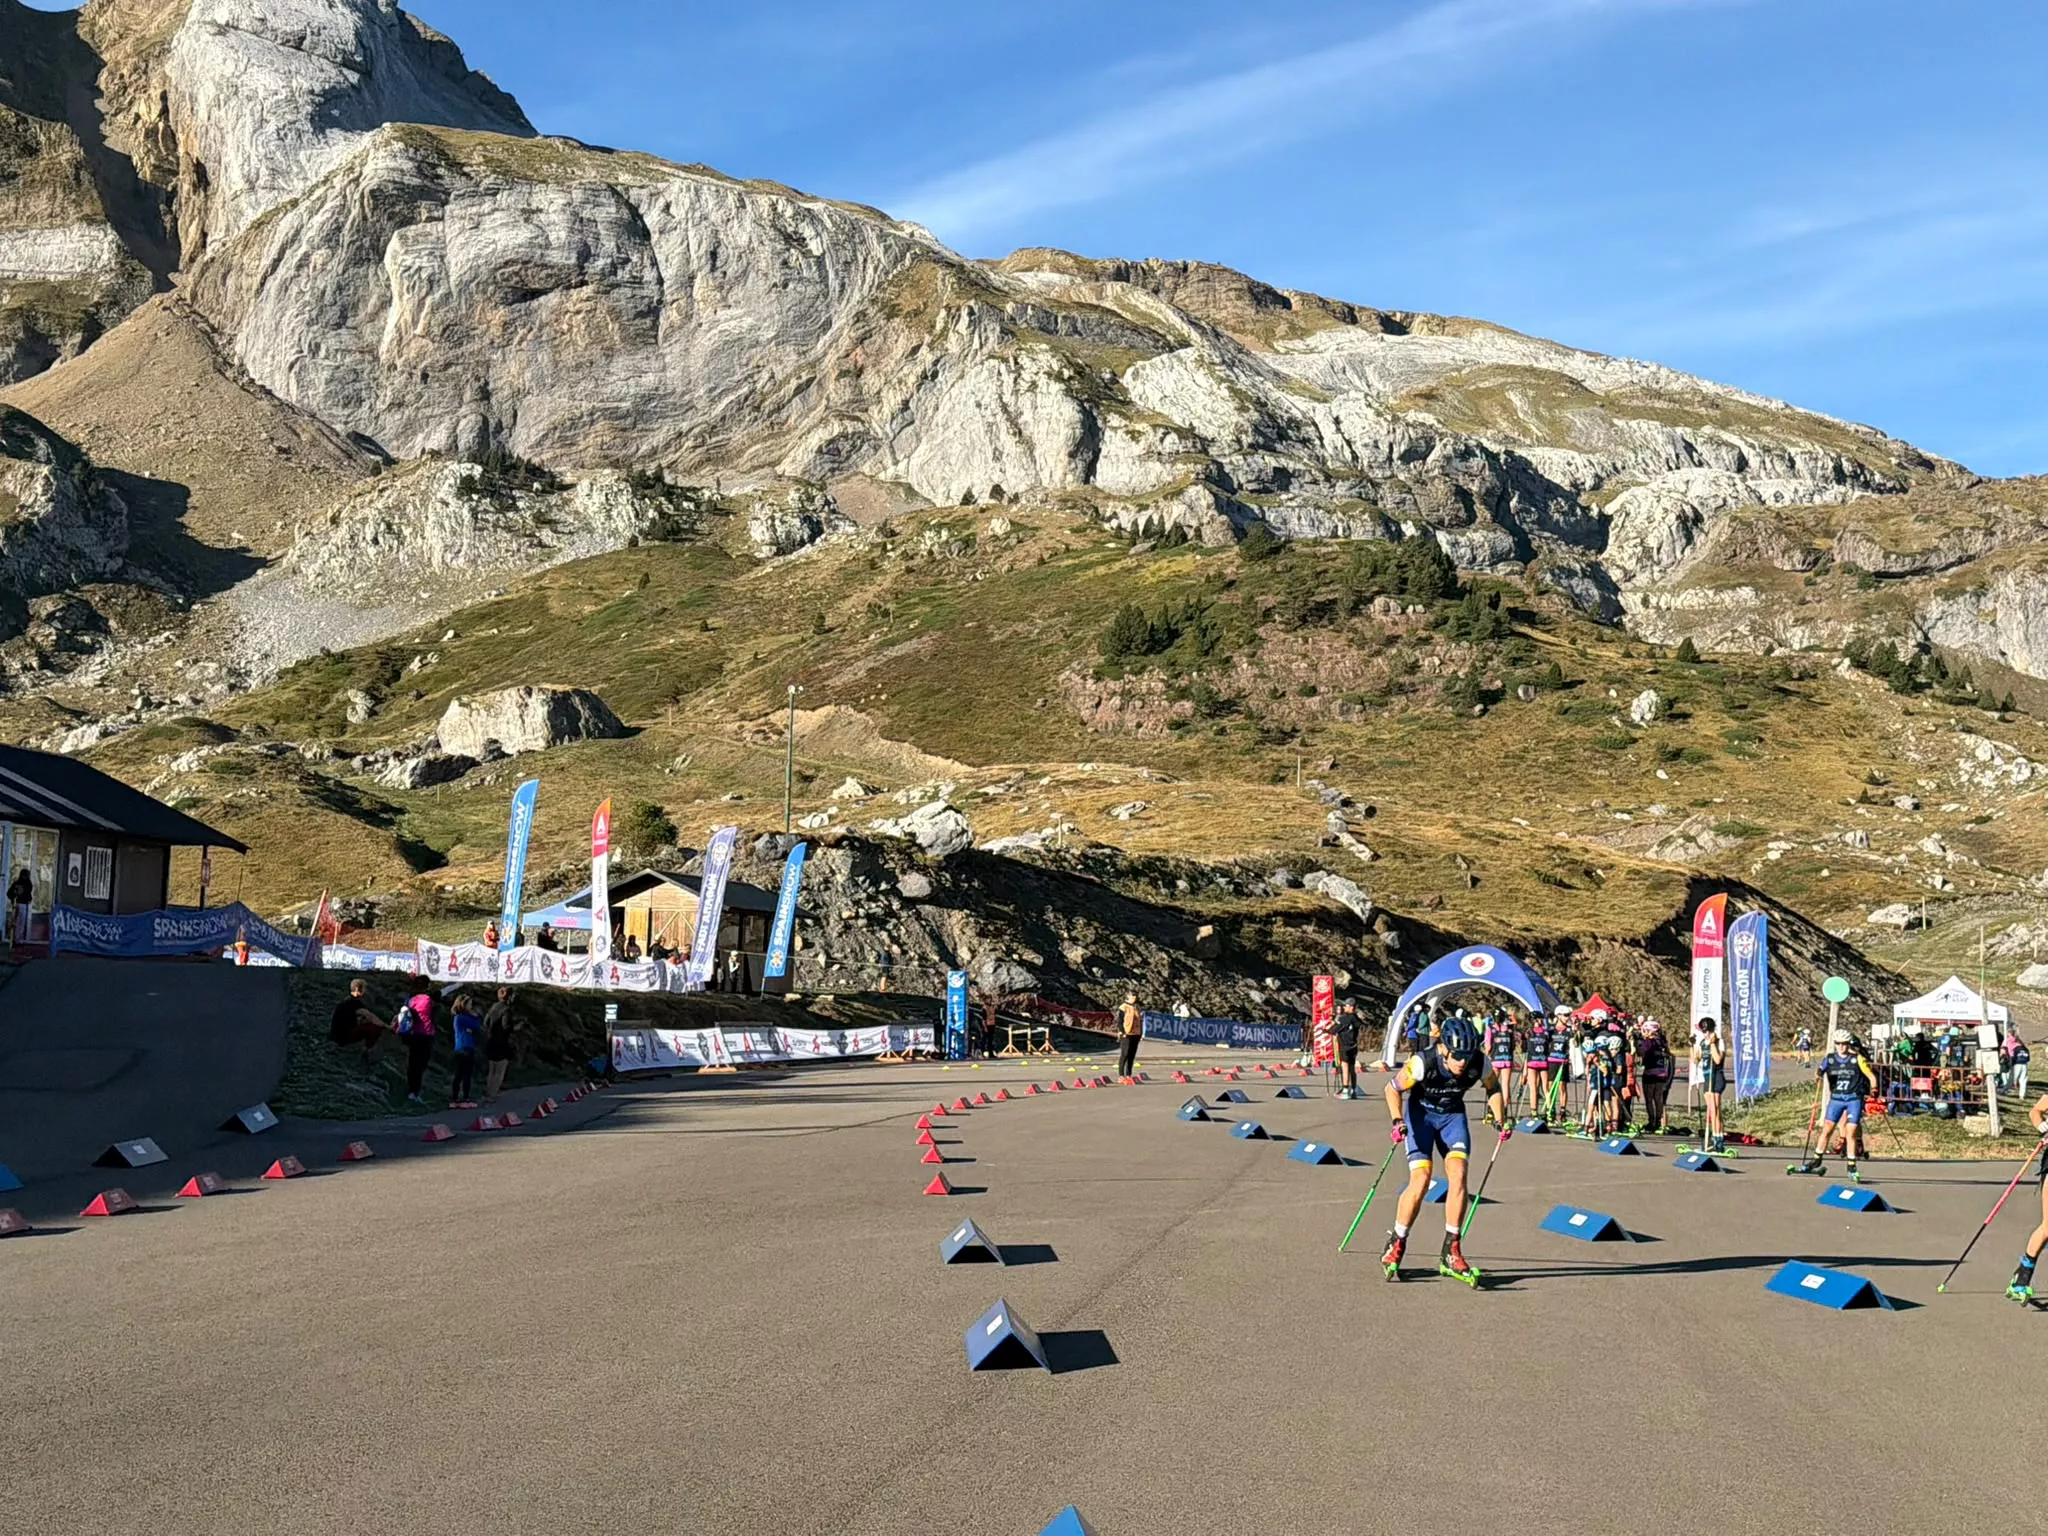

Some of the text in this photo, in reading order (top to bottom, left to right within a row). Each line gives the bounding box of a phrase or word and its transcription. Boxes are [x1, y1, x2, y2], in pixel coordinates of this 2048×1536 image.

[773, 863, 798, 946] SPAINSNOW
[1701, 967, 1710, 1007] turismo
[1736, 969, 1751, 1029] ARAGÓN
[1145, 1015, 1300, 1044] SPAINSNOW SPAINSNOW
[1742, 1029, 1754, 1061] FADI
[1836, 1080, 1850, 1091] 27
